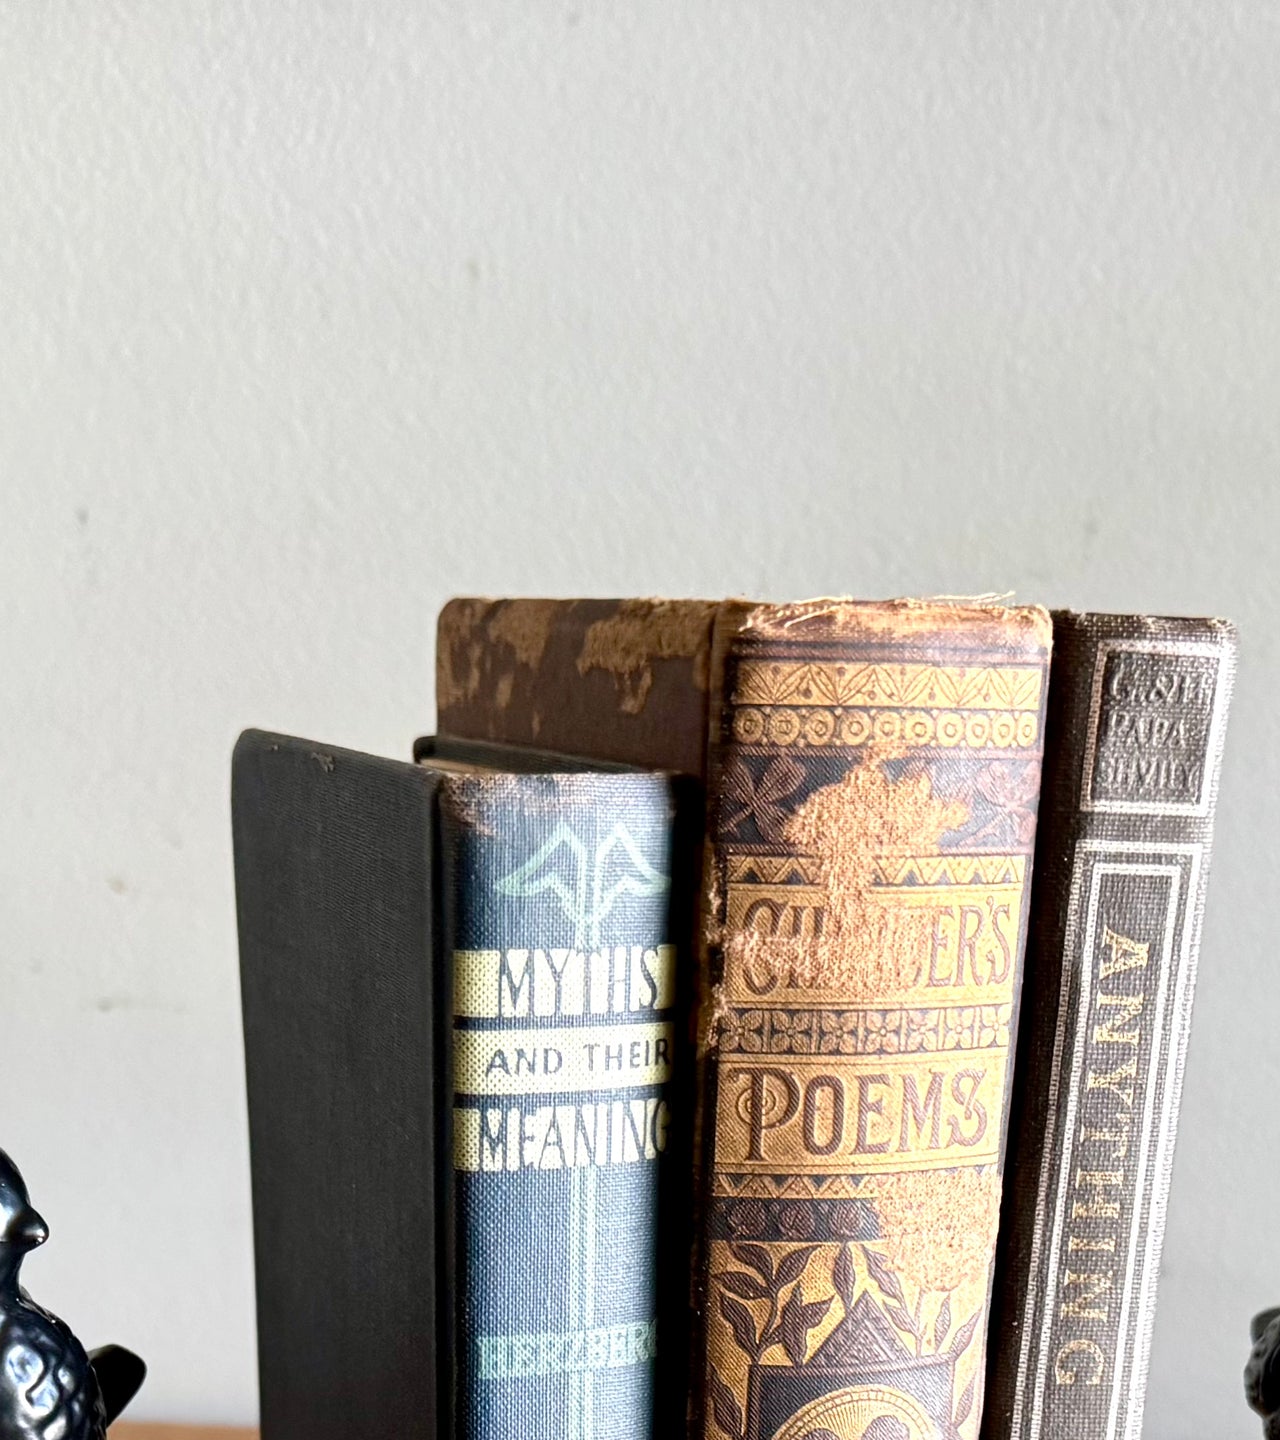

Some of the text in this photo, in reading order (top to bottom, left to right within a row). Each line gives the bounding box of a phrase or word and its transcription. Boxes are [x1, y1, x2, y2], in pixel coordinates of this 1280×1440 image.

[499, 948, 659, 1017] MYTHS
[485, 1038, 669, 1077] AND THEIR
[727, 1065, 988, 1162] POEMS
[1054, 922, 1150, 1387] ANYTHING
